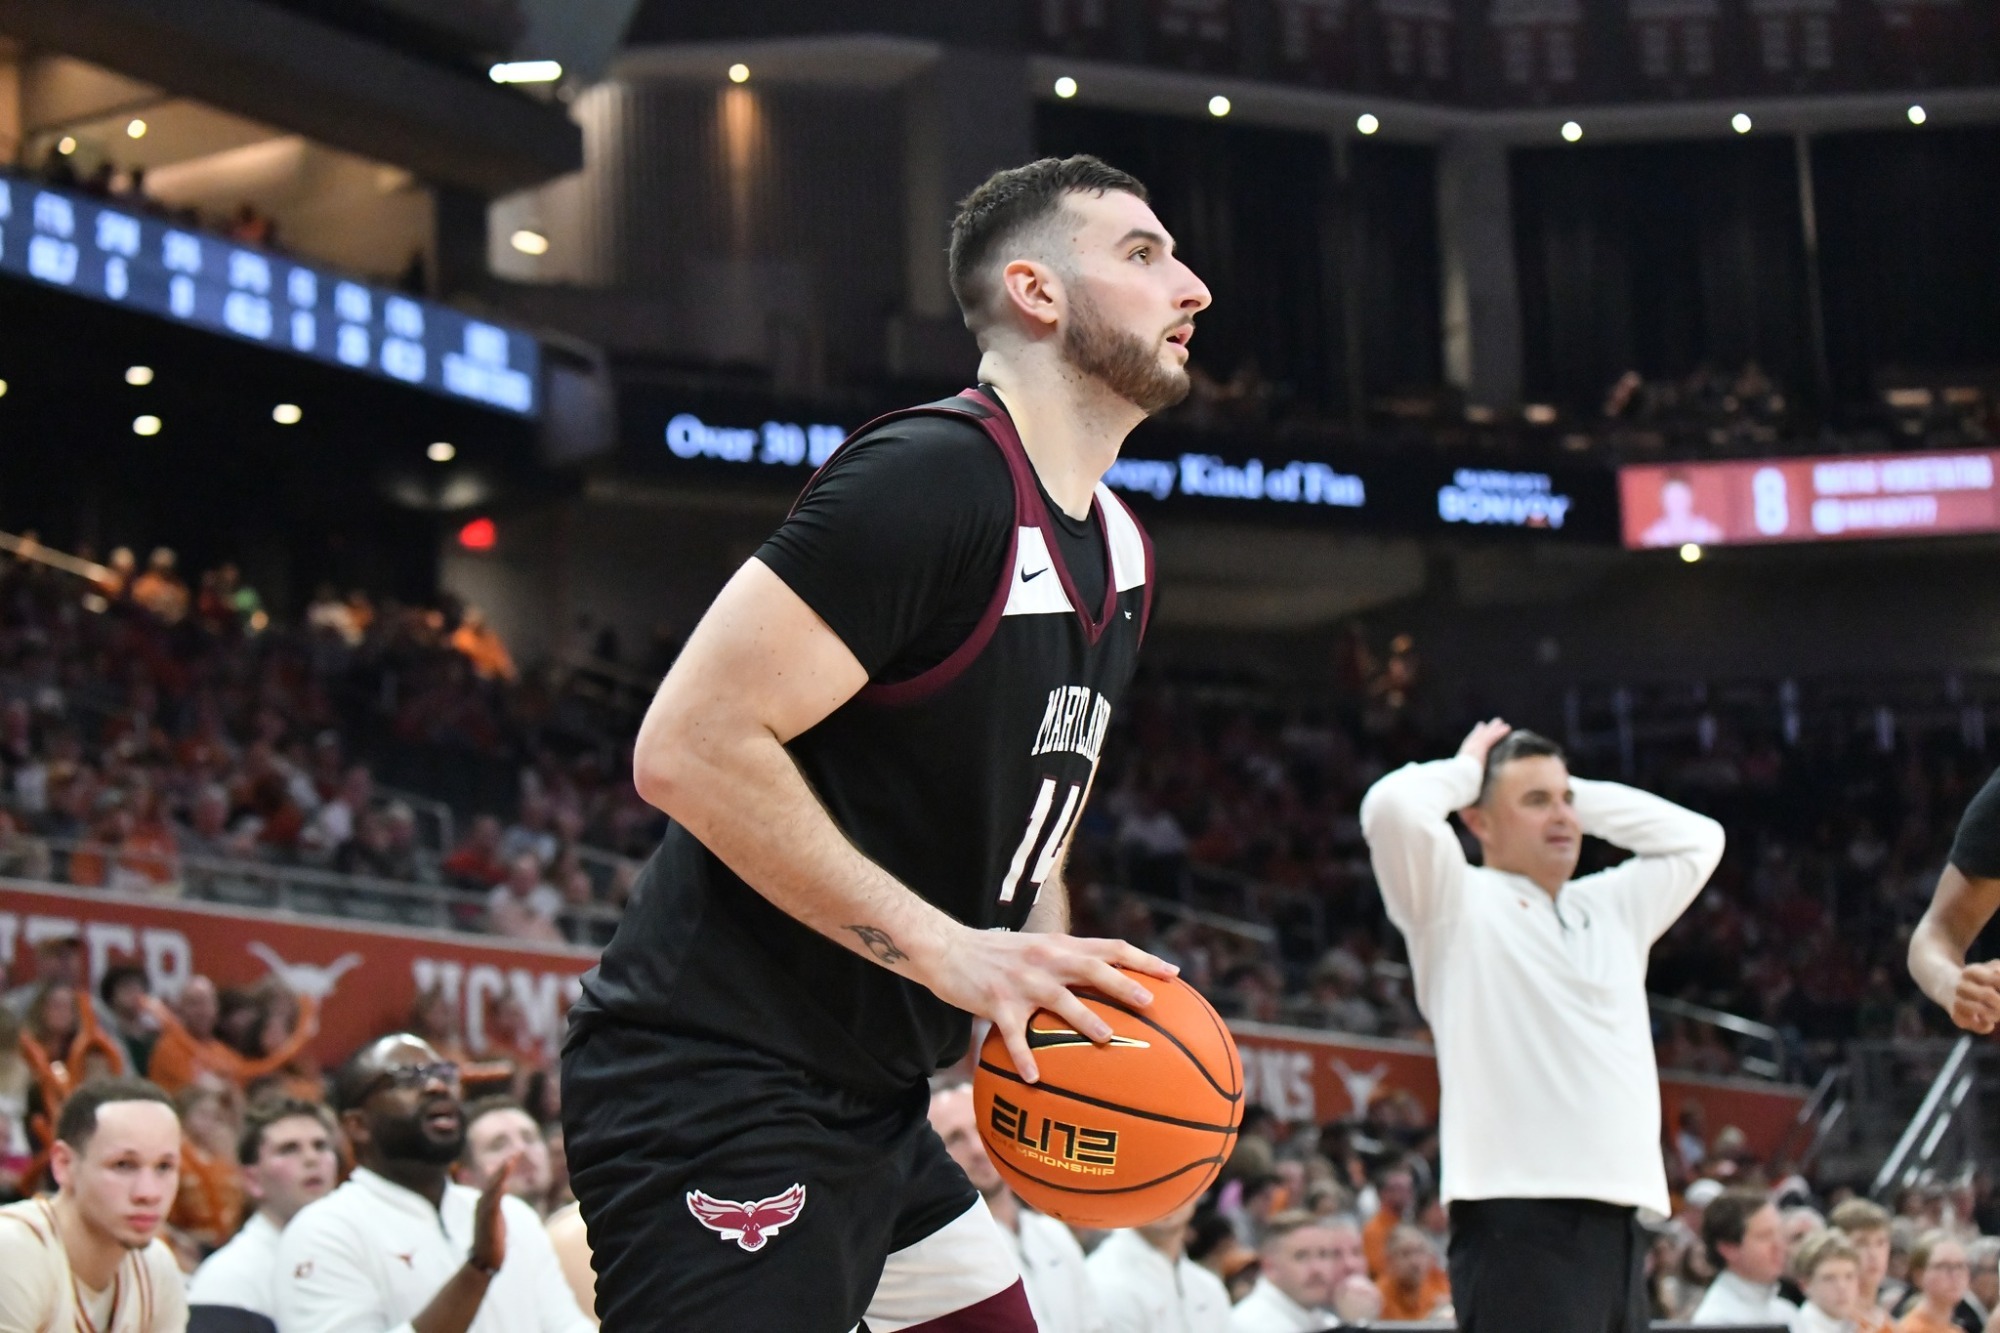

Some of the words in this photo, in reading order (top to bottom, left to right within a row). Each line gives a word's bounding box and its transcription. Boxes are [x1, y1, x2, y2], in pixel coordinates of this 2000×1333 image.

[667, 413, 758, 463] Over
[760, 420, 806, 466] 30
[1180, 453, 1263, 499] Kind
[1265, 460, 1303, 502] of
[1303, 462, 1365, 507] Fan
[999, 776, 1081, 905] 14
[991, 1093, 1119, 1167] ELITE
[991, 1130, 1115, 1176] CHAMPIONSHIP
